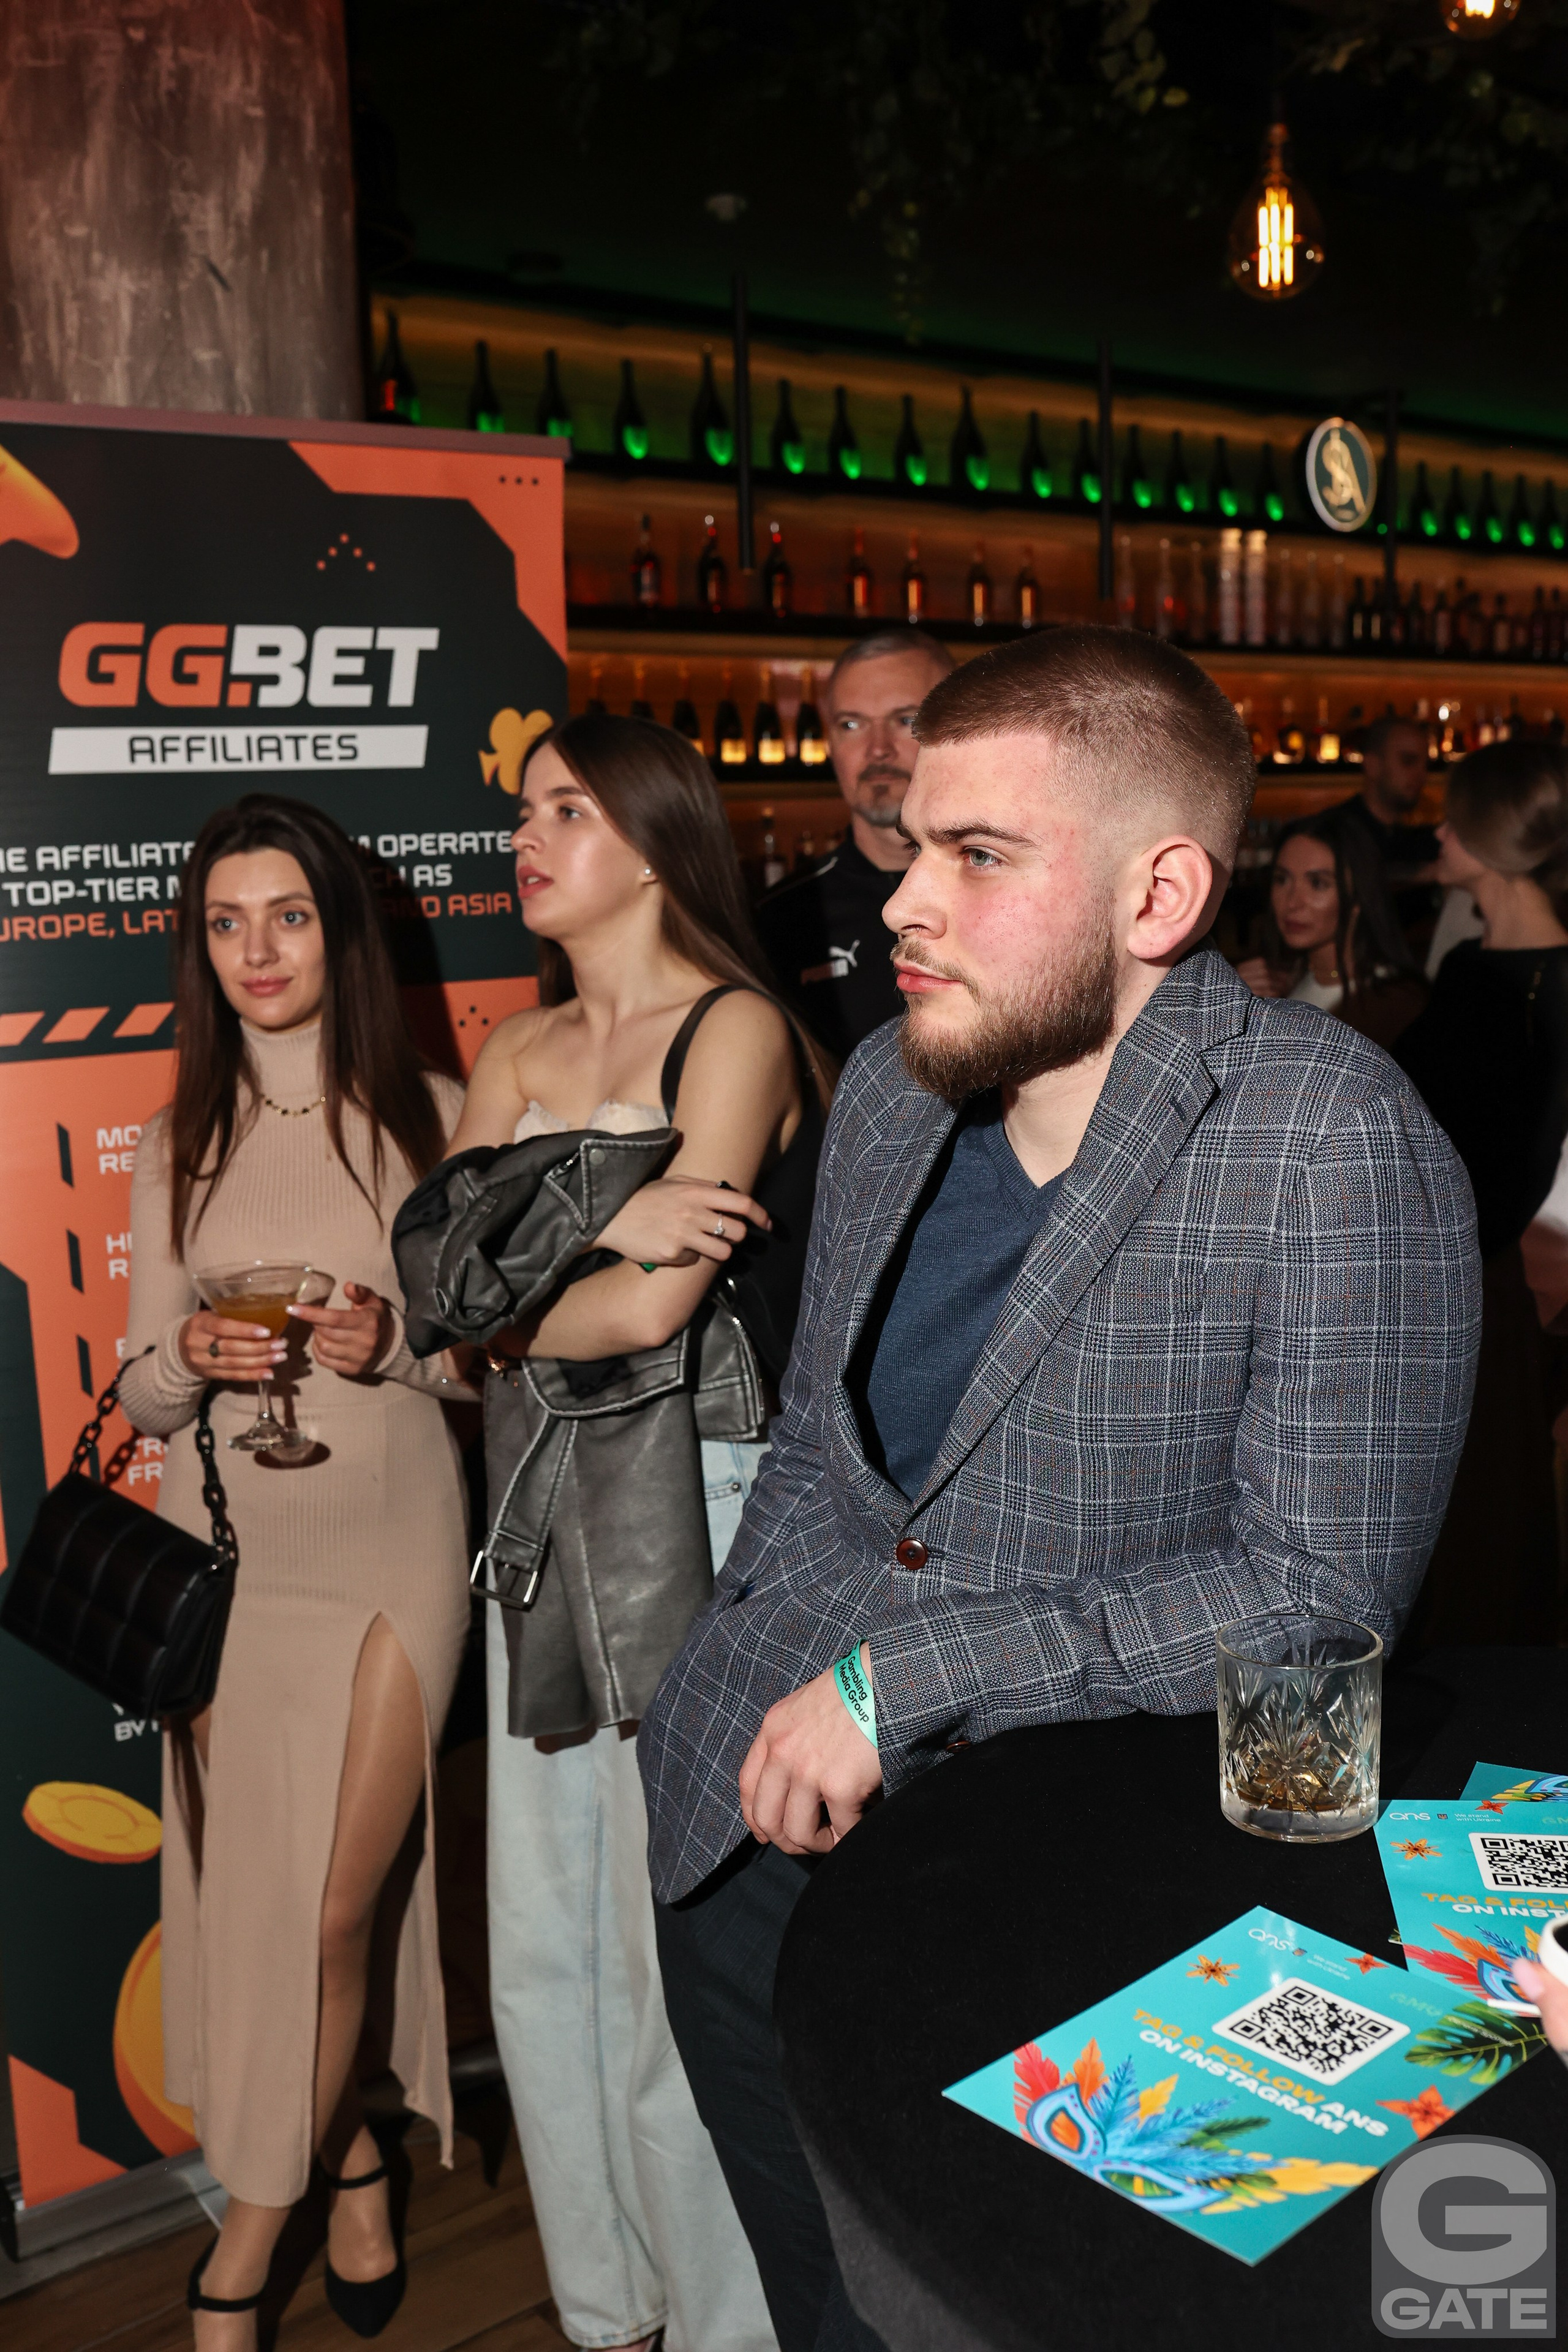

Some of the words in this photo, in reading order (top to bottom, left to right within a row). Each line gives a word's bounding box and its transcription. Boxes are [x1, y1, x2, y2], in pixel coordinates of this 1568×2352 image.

[59, 622, 439, 707] GG.BET
[128, 734, 359, 765] AFFILIATES
[1, 875, 160, 908] TOP-TIER
[412, 862, 453, 888] AS
[447, 891, 513, 917] ASIA
[839, 1663, 851, 1692] Media
[848, 1690, 870, 1723] Group
[847, 1656, 868, 1701] Gambling
[1420, 1893, 1479, 1905] TAG
[1484, 1896, 1504, 1907] &
[1451, 1904, 1494, 1915] ON
[1133, 2008, 1183, 2038] TAG
[1182, 2035, 1204, 2049] &
[1205, 2044, 1326, 2105] FOLLOW
[1320, 2101, 1390, 2138] ANS
[1139, 2029, 1182, 2054] ON
[1179, 2048, 1349, 2136] INSTAGRAM
